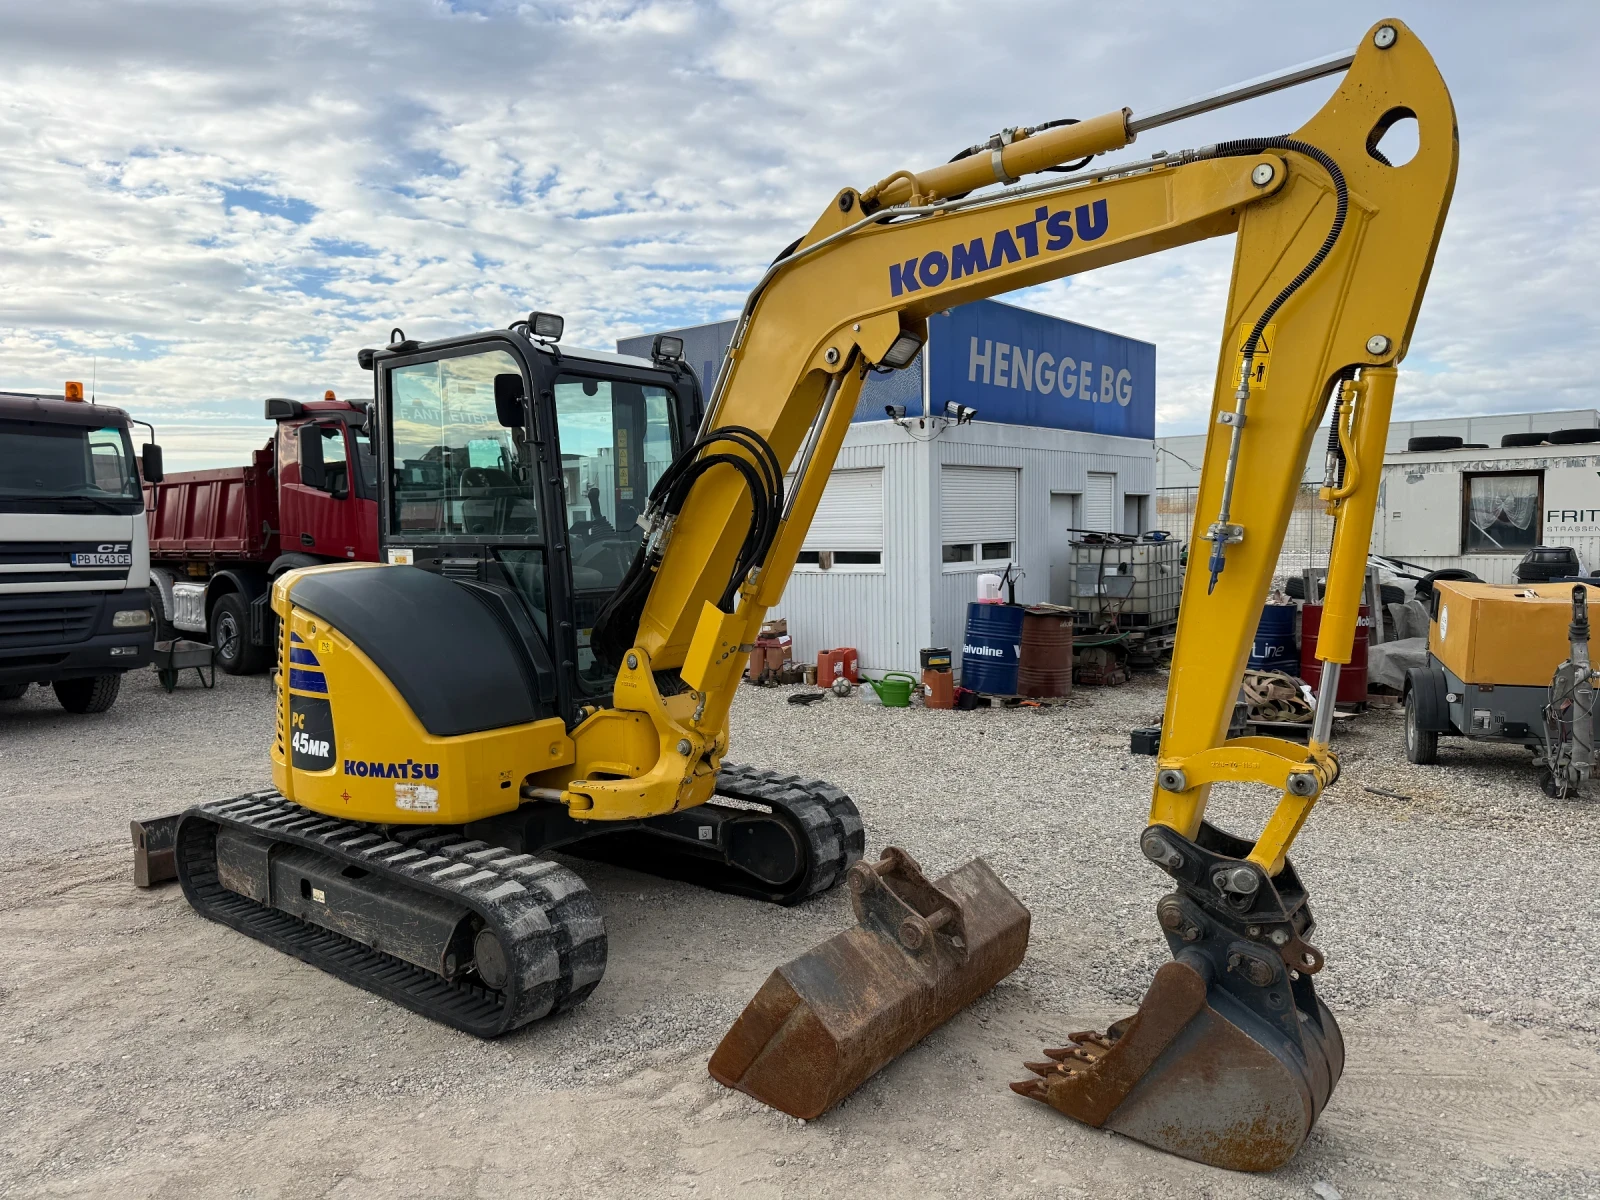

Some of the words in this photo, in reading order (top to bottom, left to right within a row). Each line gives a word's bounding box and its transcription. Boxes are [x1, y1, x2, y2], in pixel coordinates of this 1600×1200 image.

[888, 198, 1109, 297] KOMATSU
[968, 336, 1133, 407] HENGGE.BG
[77, 554, 91, 564] PB
[93, 554, 116, 564] 1643
[117, 554, 130, 564] CE
[97, 544, 128, 553] CF
[292, 712, 305, 730] PC
[292, 731, 330, 758] 45MR
[344, 758, 439, 780] KOMATSU
